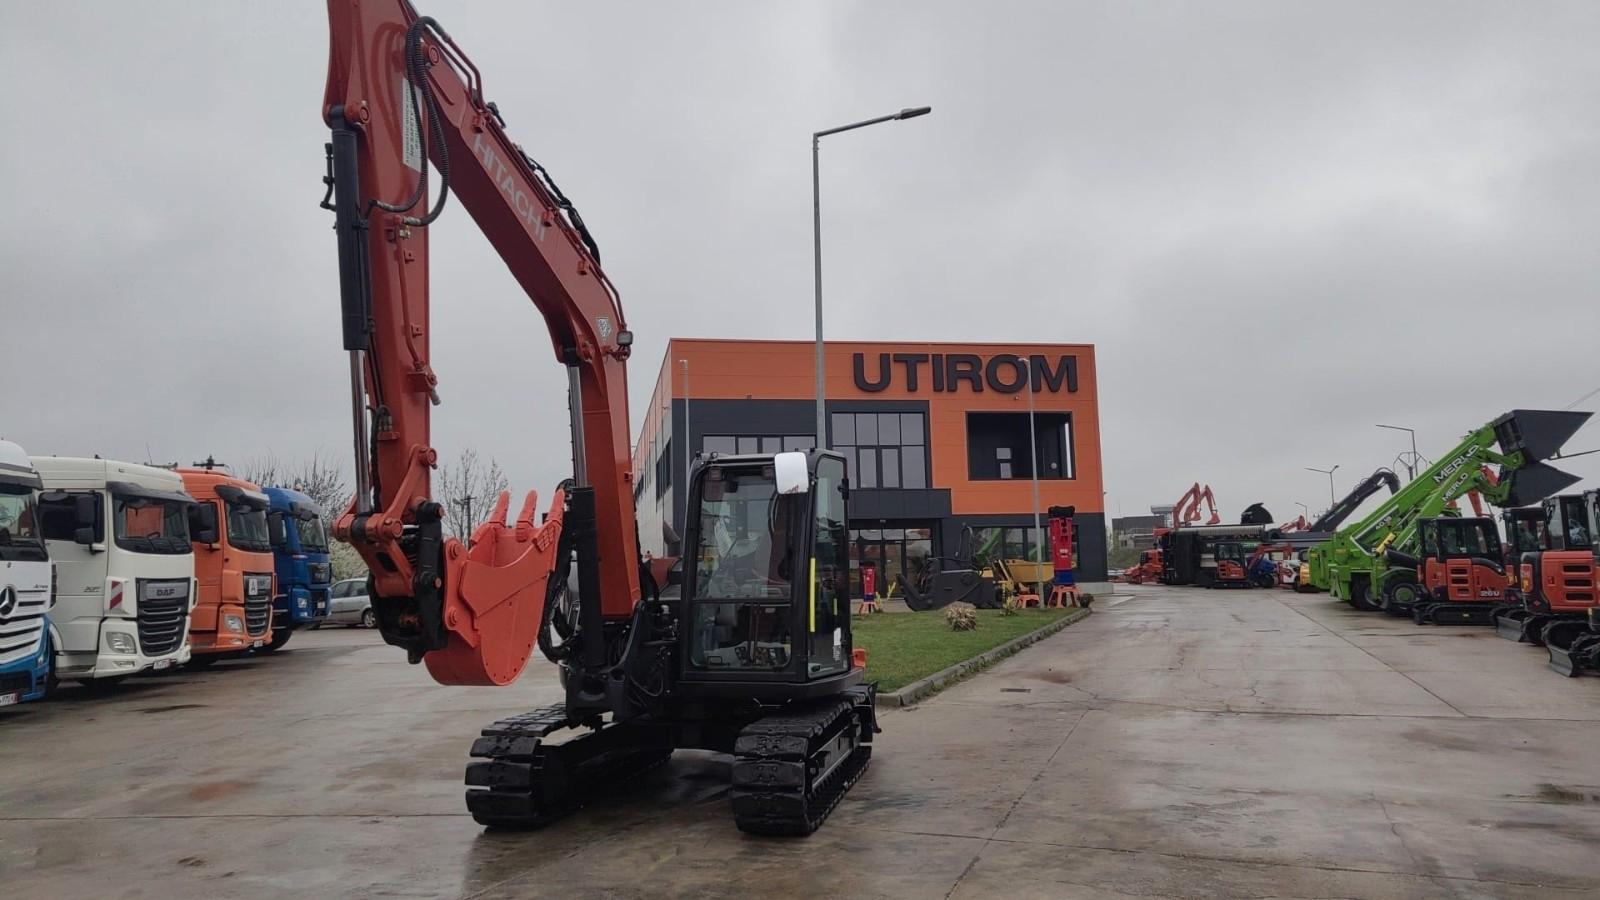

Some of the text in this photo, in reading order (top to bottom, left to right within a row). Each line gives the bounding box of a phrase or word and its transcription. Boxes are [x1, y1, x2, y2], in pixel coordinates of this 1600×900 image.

[473, 133, 546, 241] HITACHI
[853, 353, 1078, 393] UTIROM
[1441, 472, 1468, 501] MERLO
[156, 588, 175, 597] DAF
